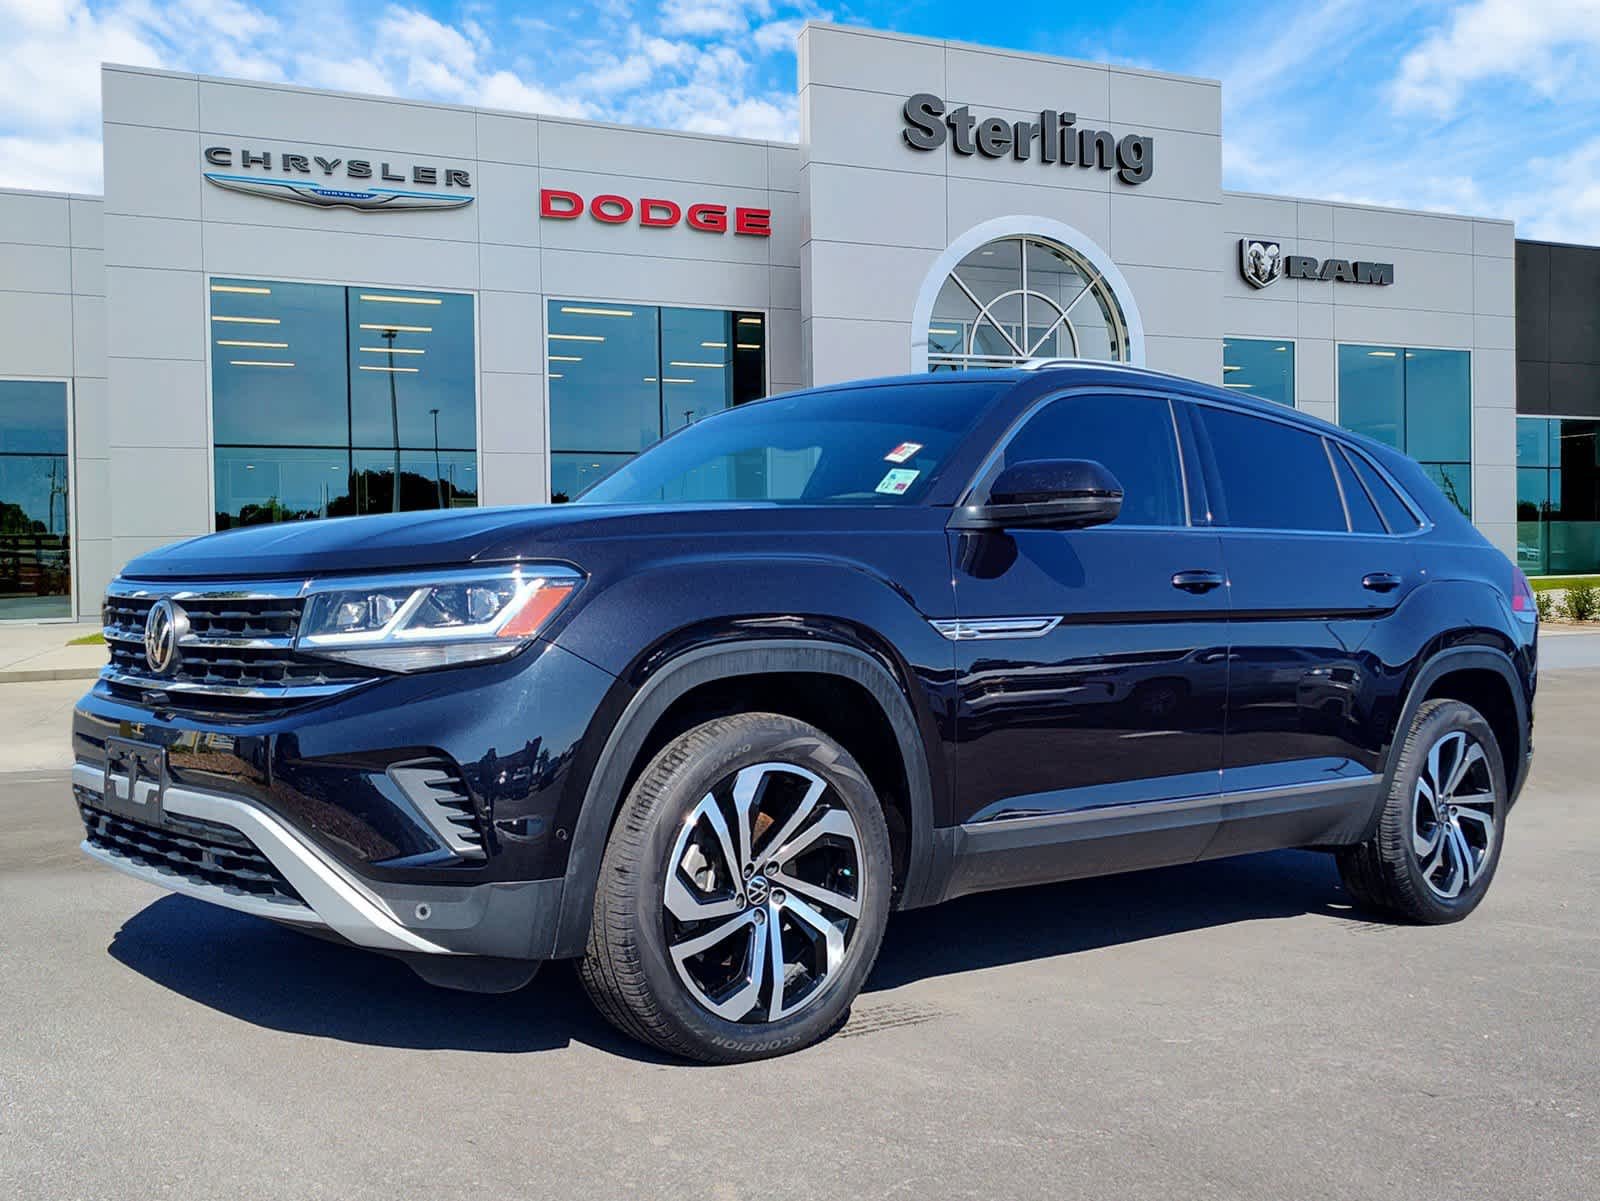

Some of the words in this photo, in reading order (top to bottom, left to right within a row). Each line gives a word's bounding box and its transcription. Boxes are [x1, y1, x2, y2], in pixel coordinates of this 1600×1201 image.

[903, 93, 1154, 184] Sterling
[204, 147, 472, 187] CHRYSLER
[540, 188, 771, 236] DODGE
[1285, 255, 1394, 286] RAM
